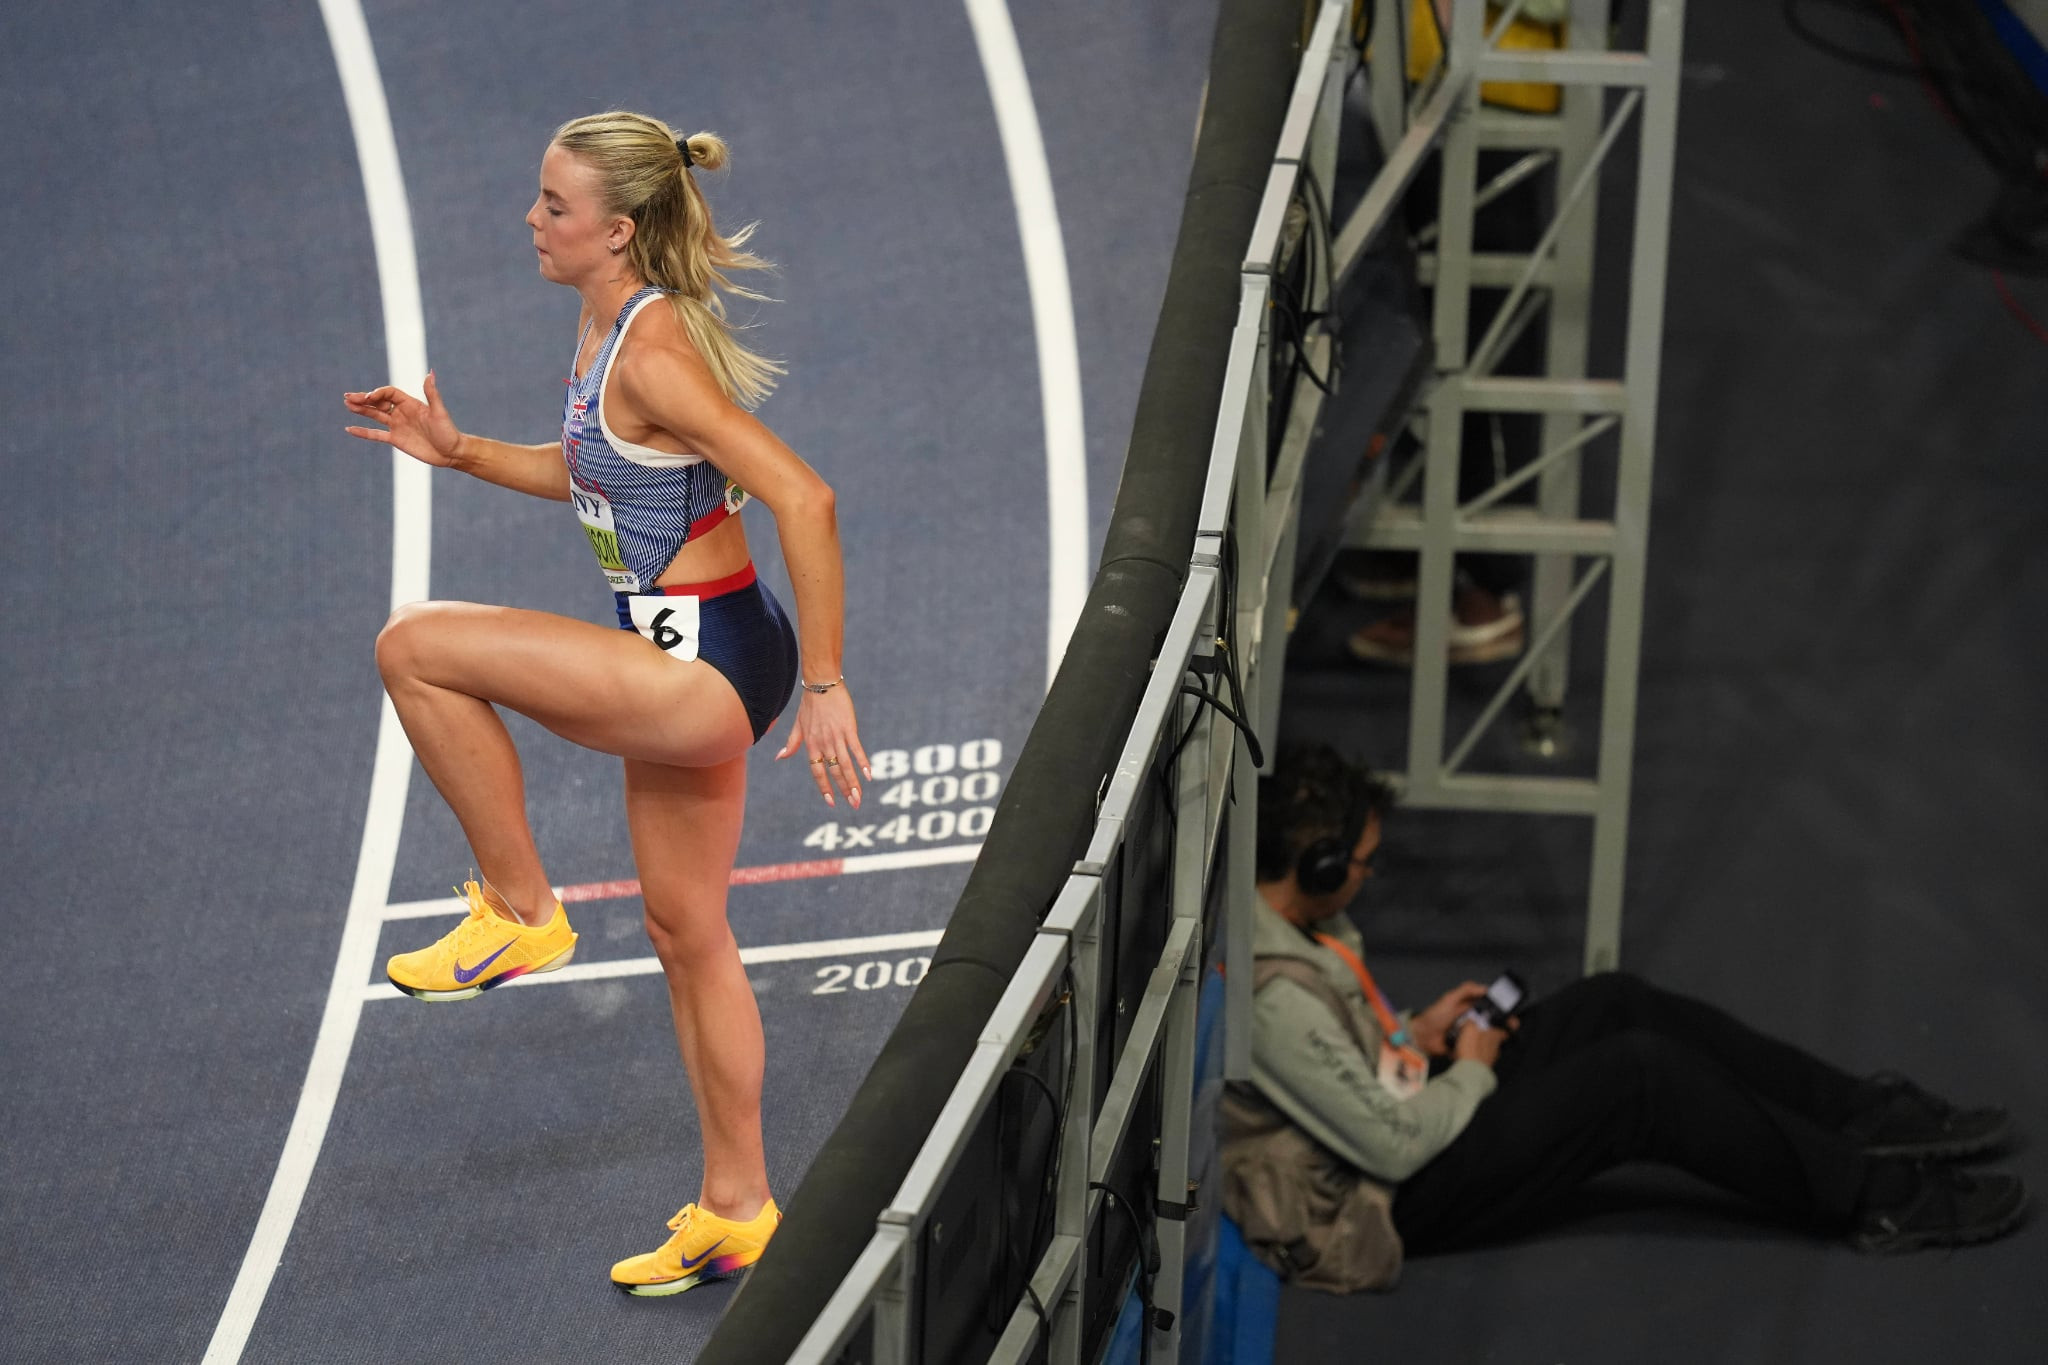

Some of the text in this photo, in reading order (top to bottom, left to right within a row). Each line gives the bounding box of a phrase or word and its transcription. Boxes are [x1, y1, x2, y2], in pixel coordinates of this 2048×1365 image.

[650, 607, 684, 651] 6
[870, 738, 1003, 781] 800
[880, 771, 1000, 808] 400
[803, 806, 996, 851] 4x400
[812, 957, 932, 995] 200
